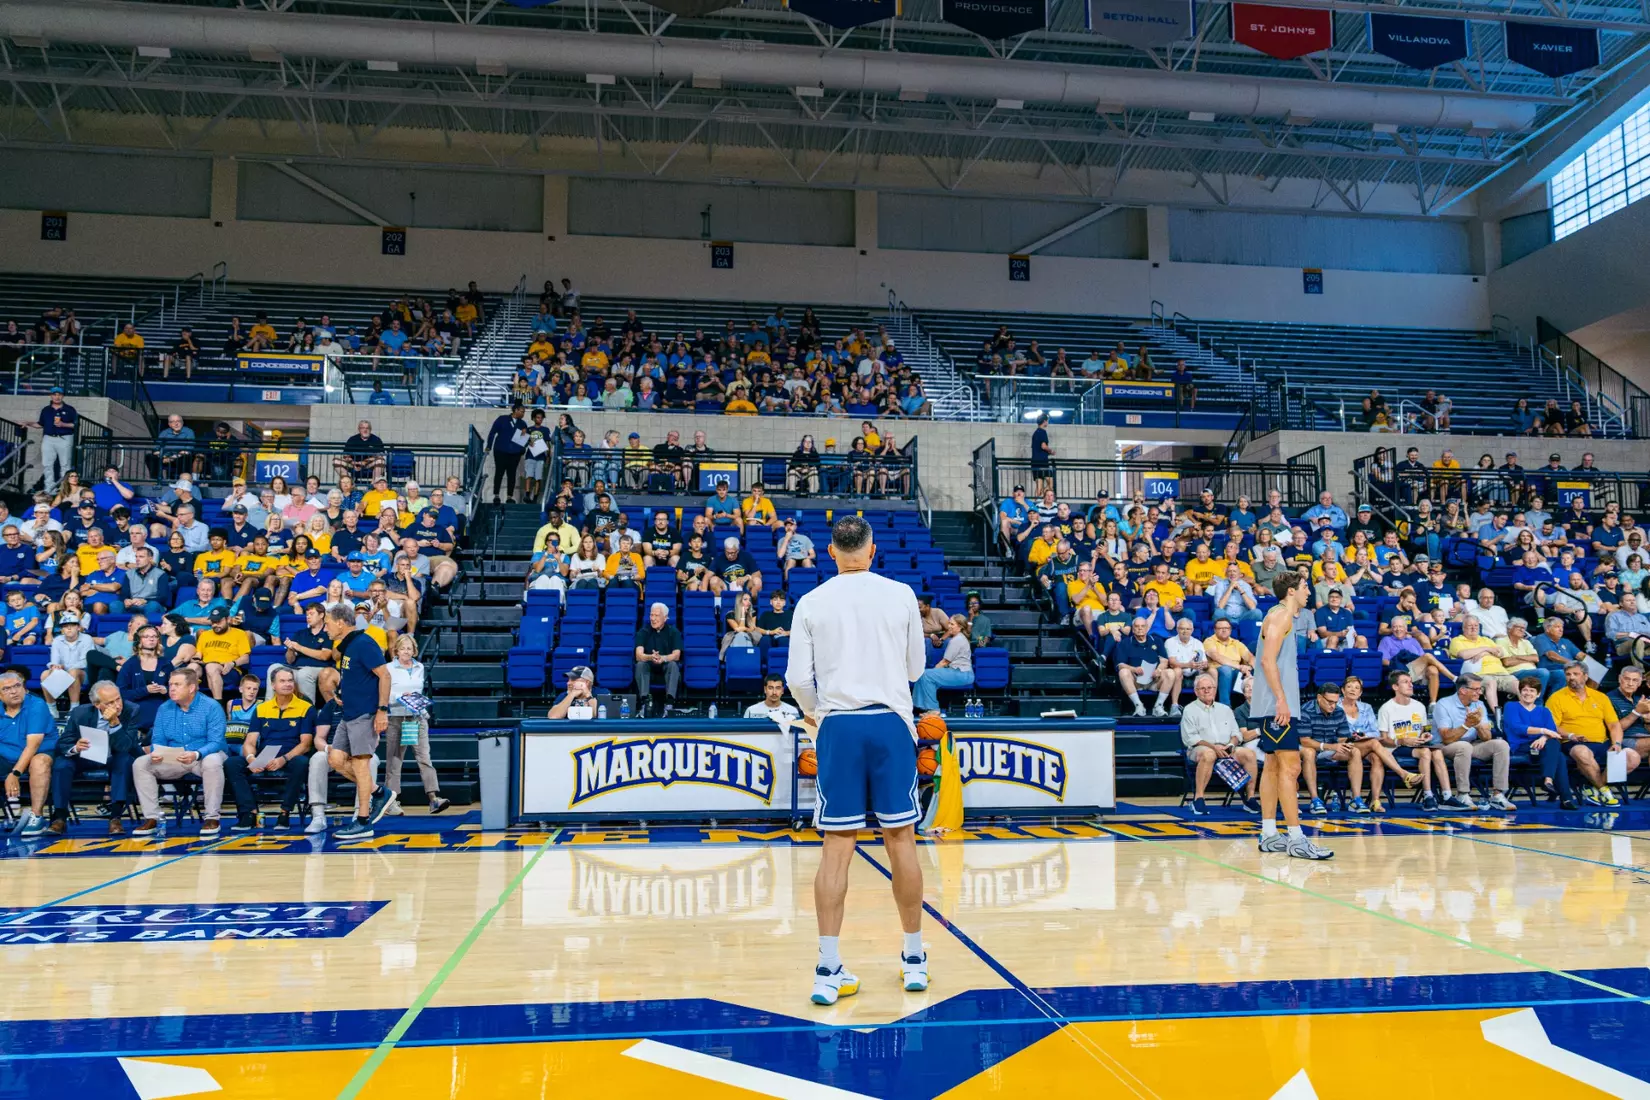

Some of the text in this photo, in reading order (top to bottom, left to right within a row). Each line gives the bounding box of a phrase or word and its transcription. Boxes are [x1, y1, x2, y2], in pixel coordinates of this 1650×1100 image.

[955, 2, 1034, 14] PROVIDENCE
[1249, 23, 1316, 35] ST. JOHN'S
[1388, 34, 1451, 45] VILLANOVA
[1532, 42, 1573, 53] XAVIER
[45, 217, 63, 227] 201
[47, 229, 61, 238] GA
[386, 232, 402, 242] 202
[387, 244, 400, 253] GA
[715, 247, 730, 256] 203
[716, 258, 729, 267] GA
[1012, 260, 1026, 269] 204
[1013, 271, 1026, 280] GA
[1306, 274, 1320, 282] 205
[1307, 284, 1320, 293] GA
[251, 362, 309, 370] CONCESSIONS
[265, 390, 278, 400] EXIT
[1114, 388, 1163, 396] CONCESSIONS
[264, 464, 290, 478] 102
[1150, 482, 1174, 495] 104
[579, 742, 771, 798] MARQUETTE
[34, 835, 309, 854] WE
